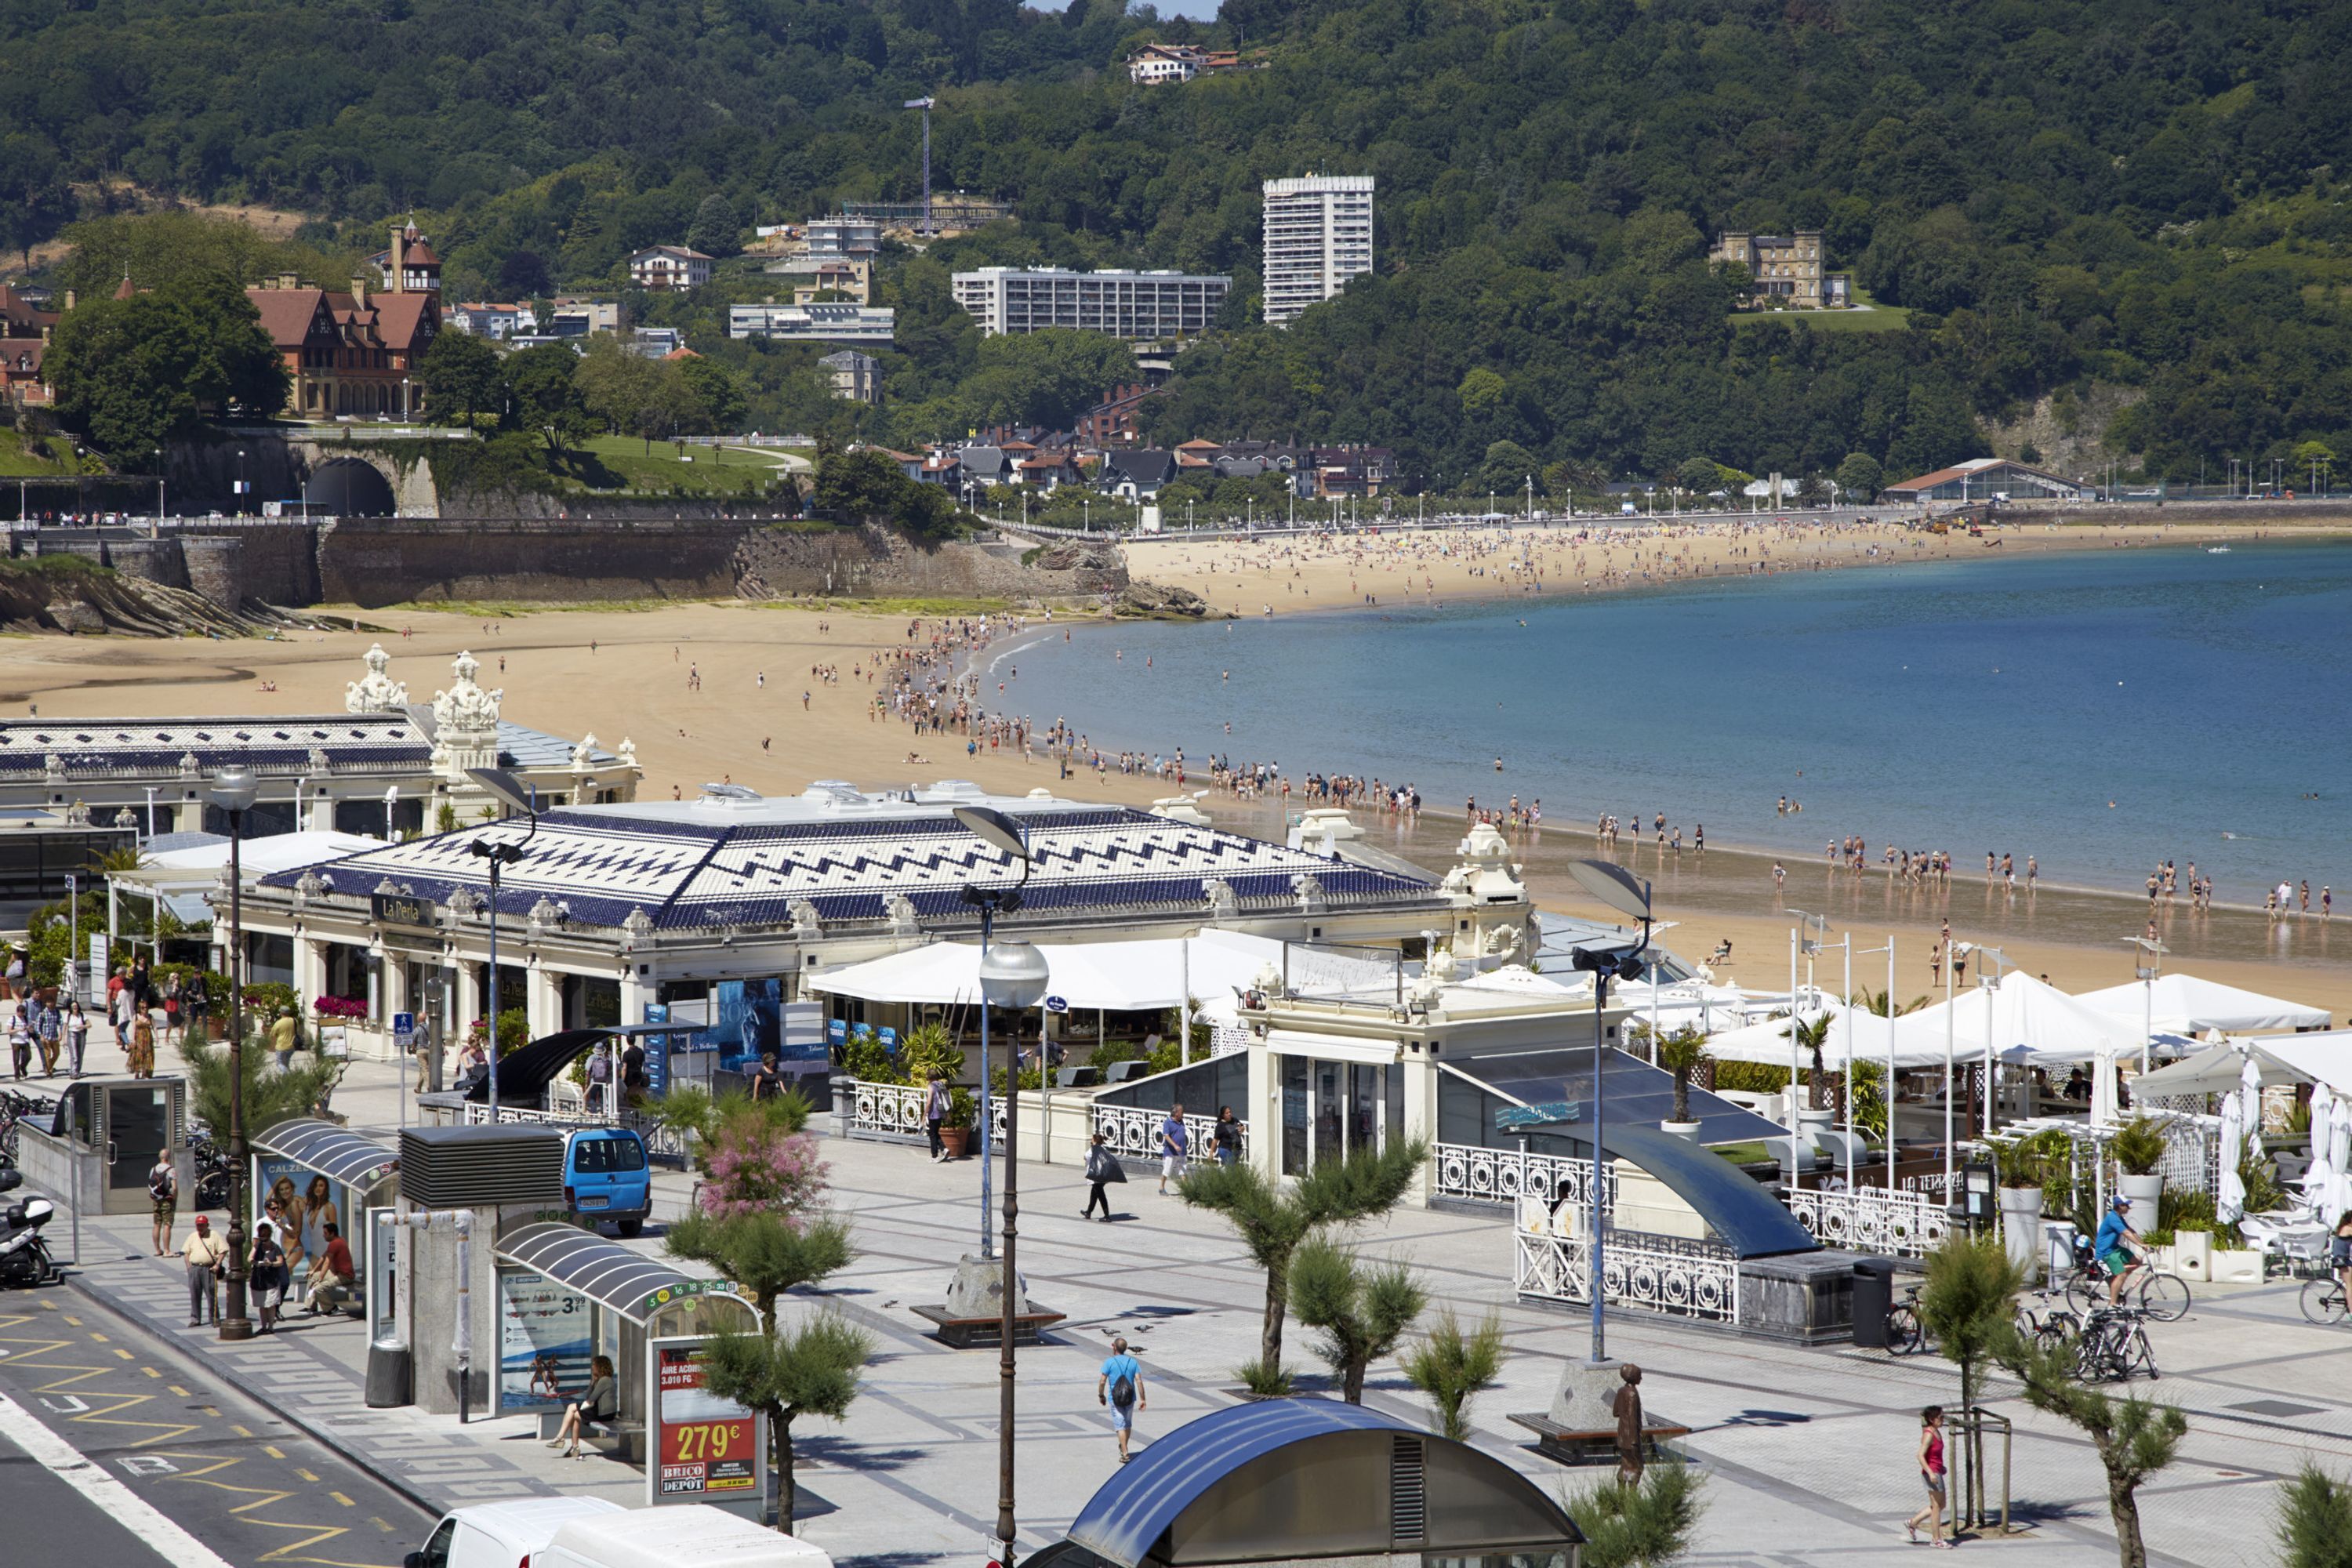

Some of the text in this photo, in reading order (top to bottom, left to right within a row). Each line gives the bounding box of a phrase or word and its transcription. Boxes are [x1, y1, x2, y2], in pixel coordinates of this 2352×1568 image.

[968, 428, 976, 437] H
[383, 898, 419, 921] La Perla
[502, 980, 510, 995] La
[1902, 1177, 1915, 1192] LA
[1918, 1171, 1964, 1191] TERRZA
[650, 1298, 656, 1306] 5
[674, 1286, 683, 1295] 16
[702, 1282, 713, 1290] 25
[661, 1364, 702, 1375] AIRE ACOND
[661, 1376, 681, 1385] 3.010
[664, 1466, 703, 1478] BRICO
